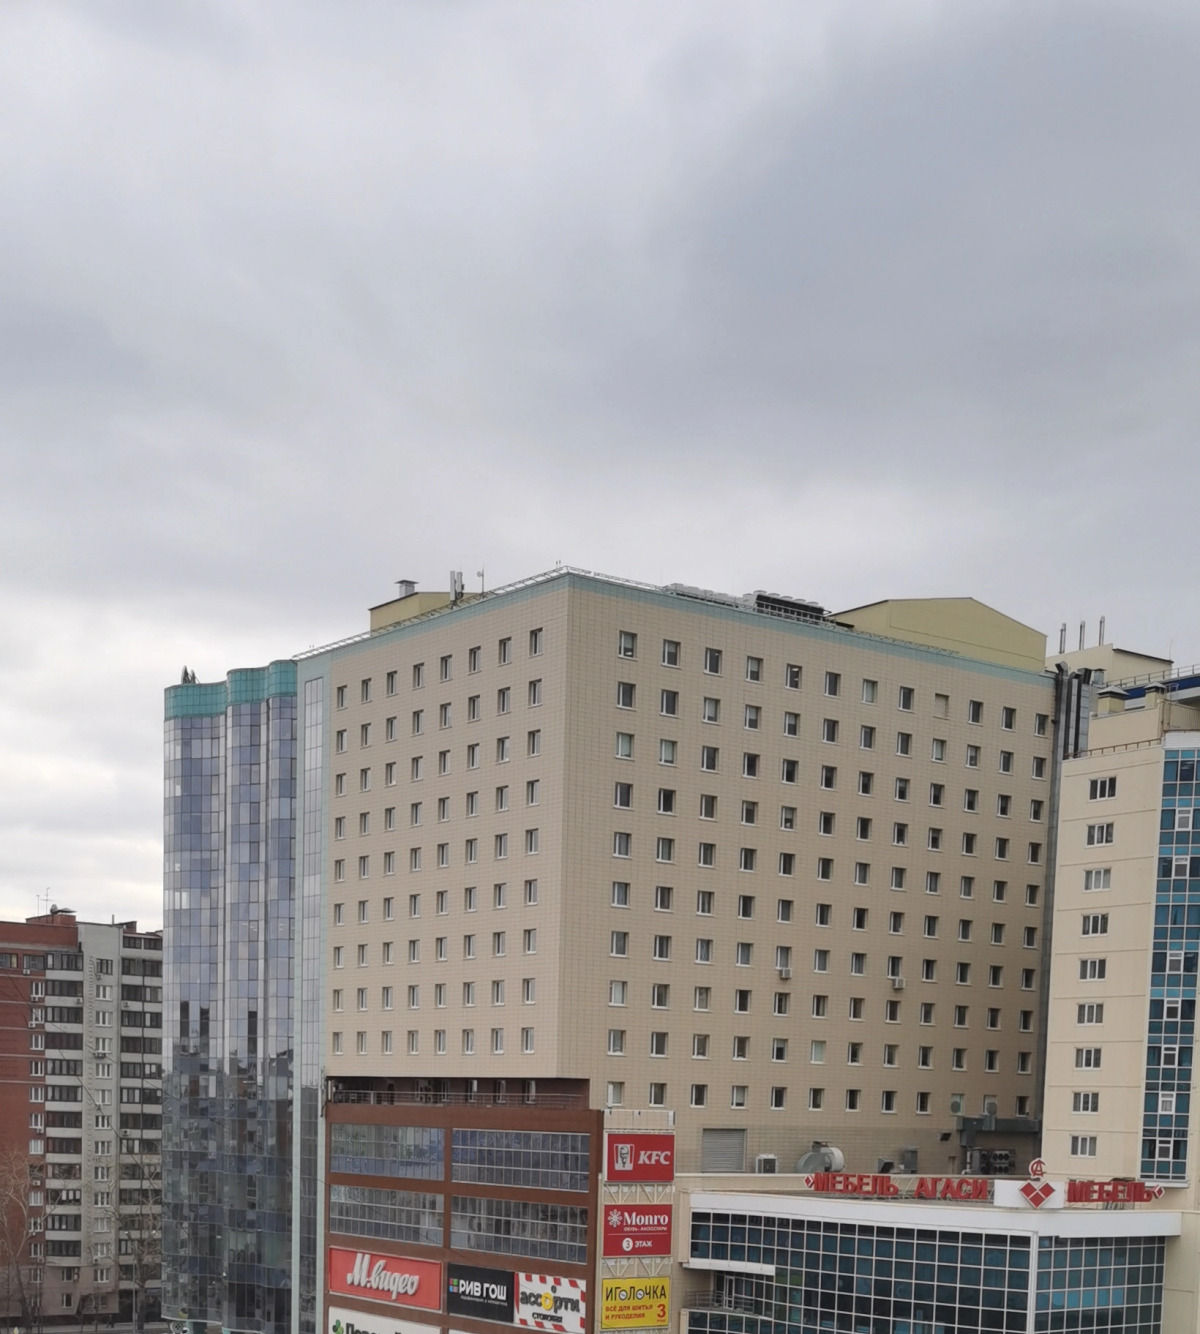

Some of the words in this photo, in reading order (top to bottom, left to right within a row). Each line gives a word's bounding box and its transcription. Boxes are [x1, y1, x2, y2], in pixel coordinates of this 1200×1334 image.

[638, 1151, 671, 1165] KFC
[814, 1172, 899, 1197] МЕБЕЛЬ
[914, 1177, 988, 1200] АГАСИ
[1066, 1181, 1153, 1203] МЕБЕЛЬ
[623, 1212, 668, 1226] Monro
[634, 1240, 653, 1248] ЭТАЖ
[459, 1279, 482, 1297] РИВ
[483, 1282, 507, 1301] ГОШ
[520, 1285, 580, 1314] ассорти
[611, 1312, 645, 1320] РУКОДЕЛИЯ
[657, 1304, 666, 1318] 3
